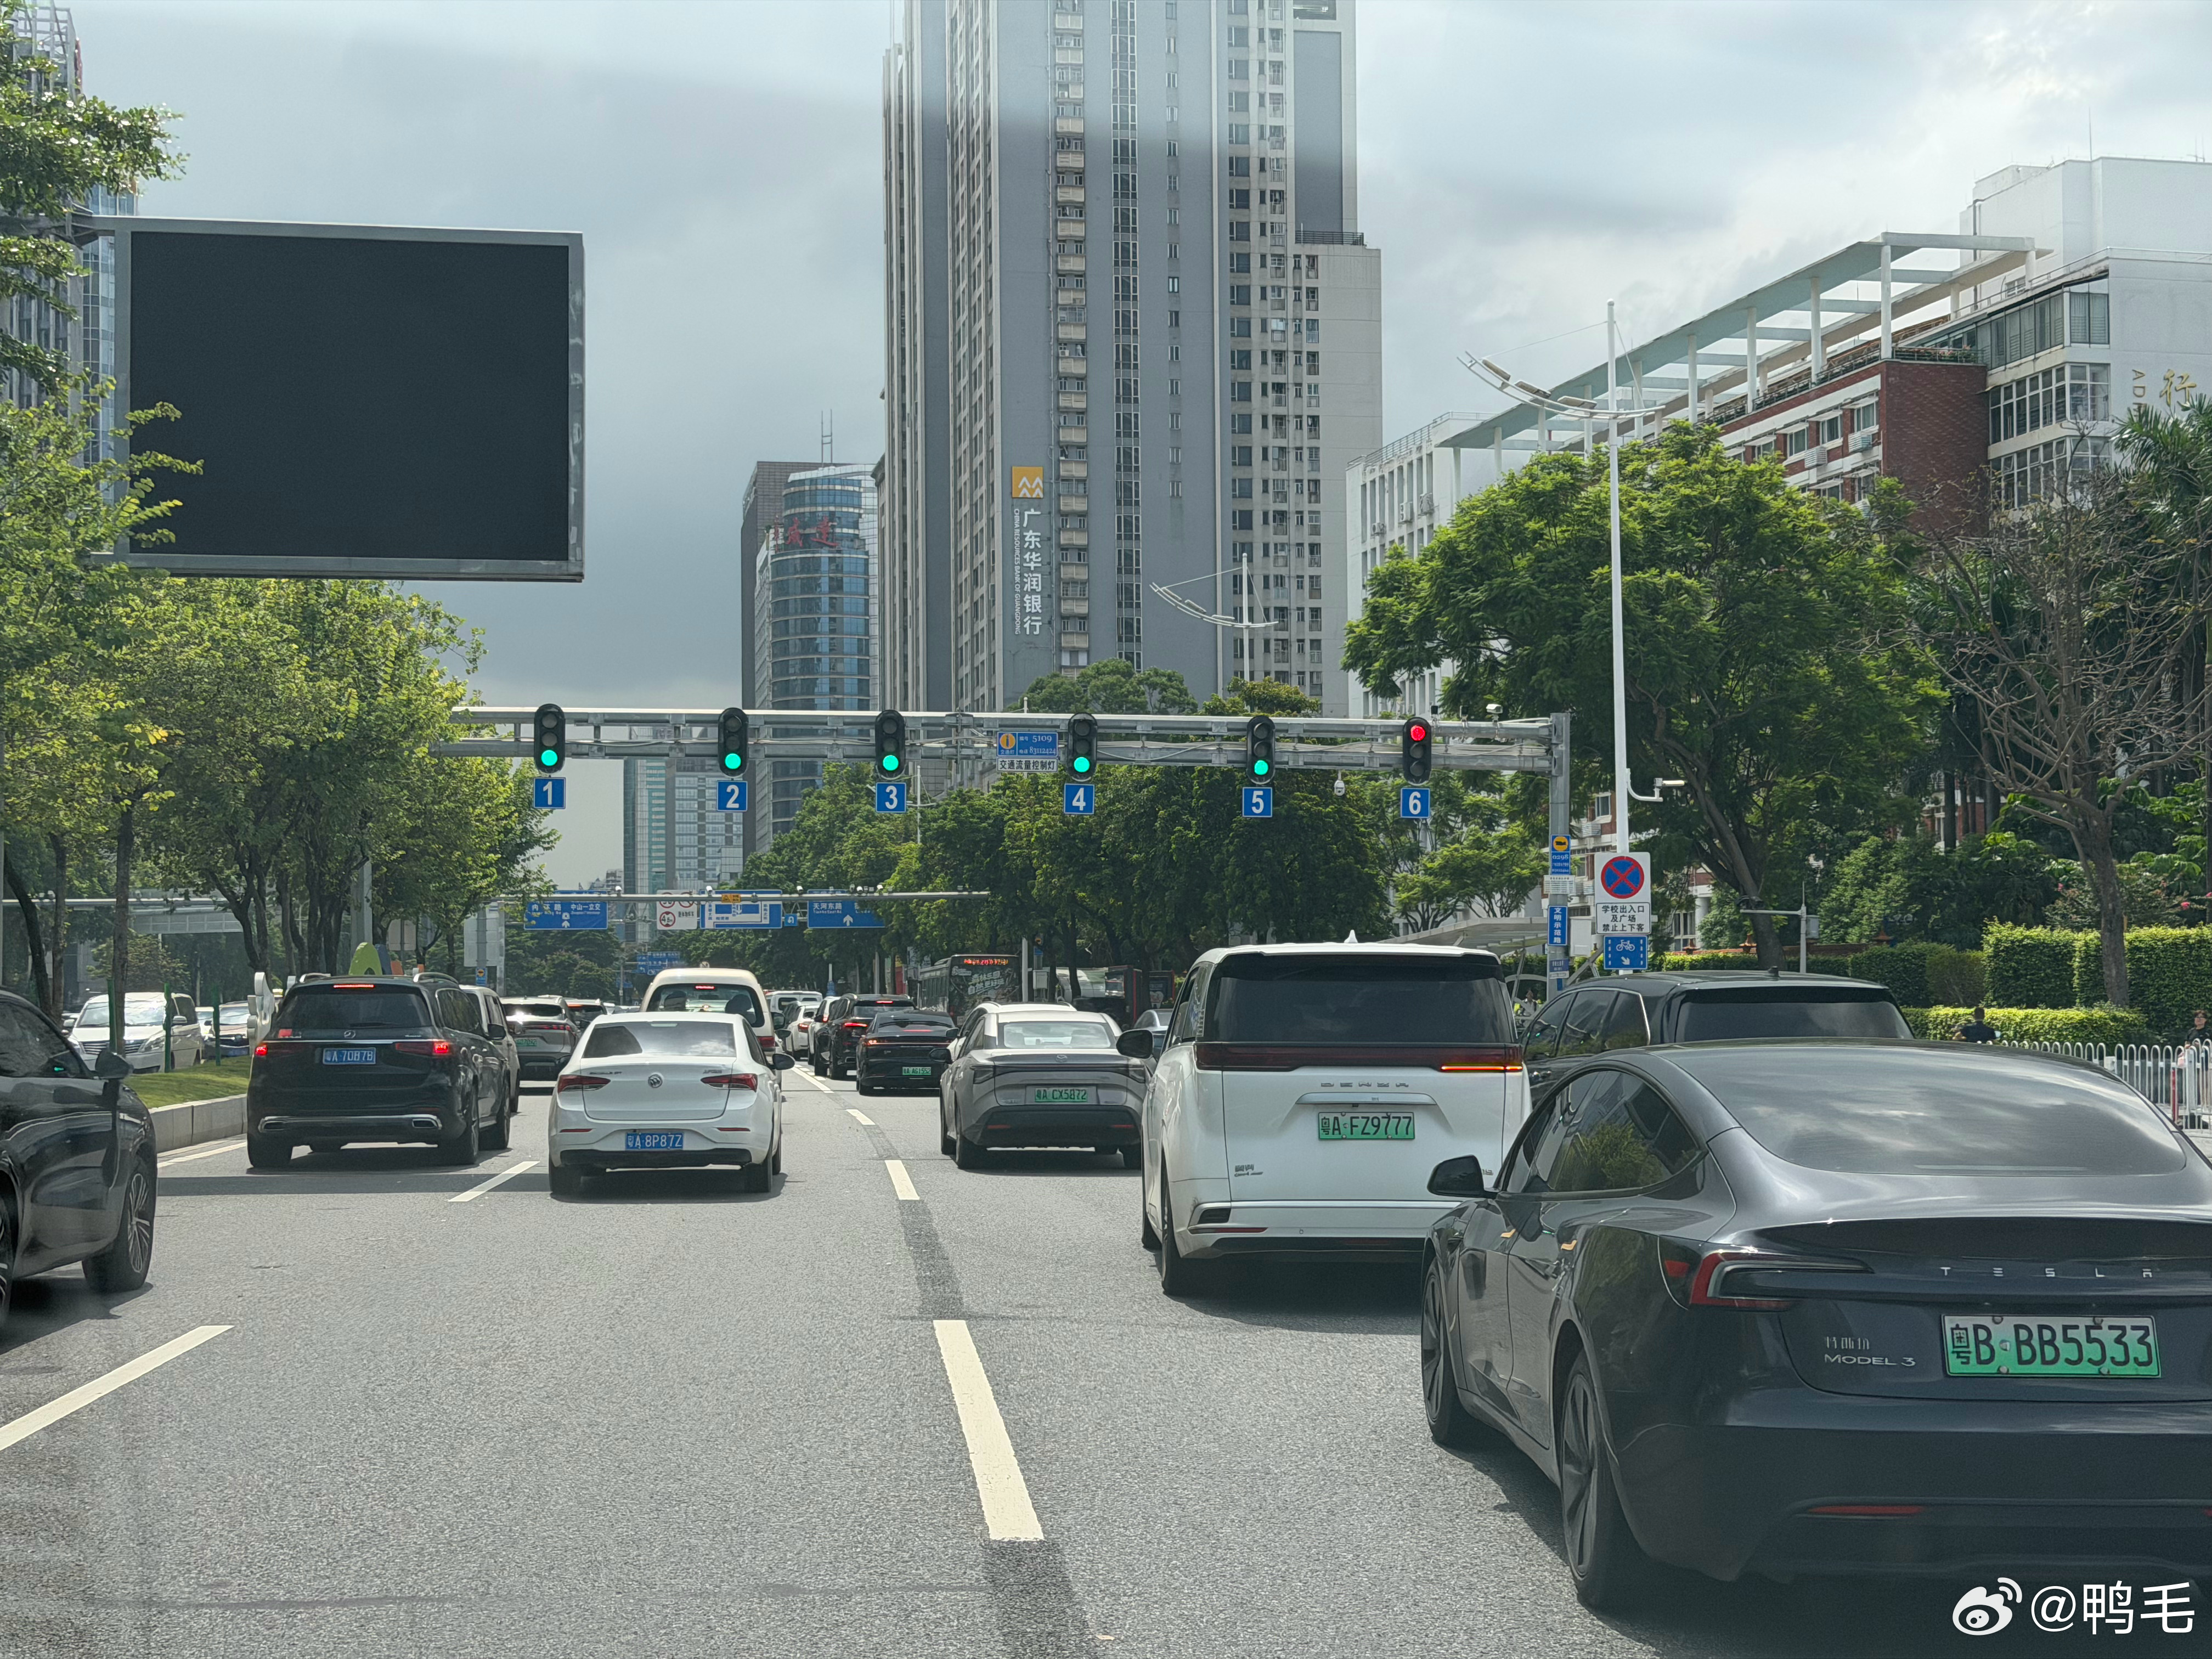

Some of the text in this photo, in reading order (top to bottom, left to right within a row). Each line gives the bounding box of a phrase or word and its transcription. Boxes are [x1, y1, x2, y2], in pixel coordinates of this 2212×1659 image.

[1023, 508, 1042, 635] 广东华润银行
[1014, 584, 1020, 592] OF
[1029, 746, 1056, 755] 83112424
[1000, 759, 1056, 770] 交通流量控制灯
[543, 781, 552, 805] 1
[726, 785, 739, 809] 2
[885, 786, 898, 809] 3
[1072, 788, 1086, 811] 4
[1251, 791, 1264, 814] 5
[1409, 792, 1421, 815] 6
[1601, 905, 1644, 914] 学校出入口
[1611, 914, 1636, 923] 及广场
[1553, 907, 1562, 944] 文明示范路
[1602, 923, 1645, 932] 禁止上下客
[1940, 1266, 2153, 1278] TESLA
[1824, 1354, 1916, 1367] MODEL 3
